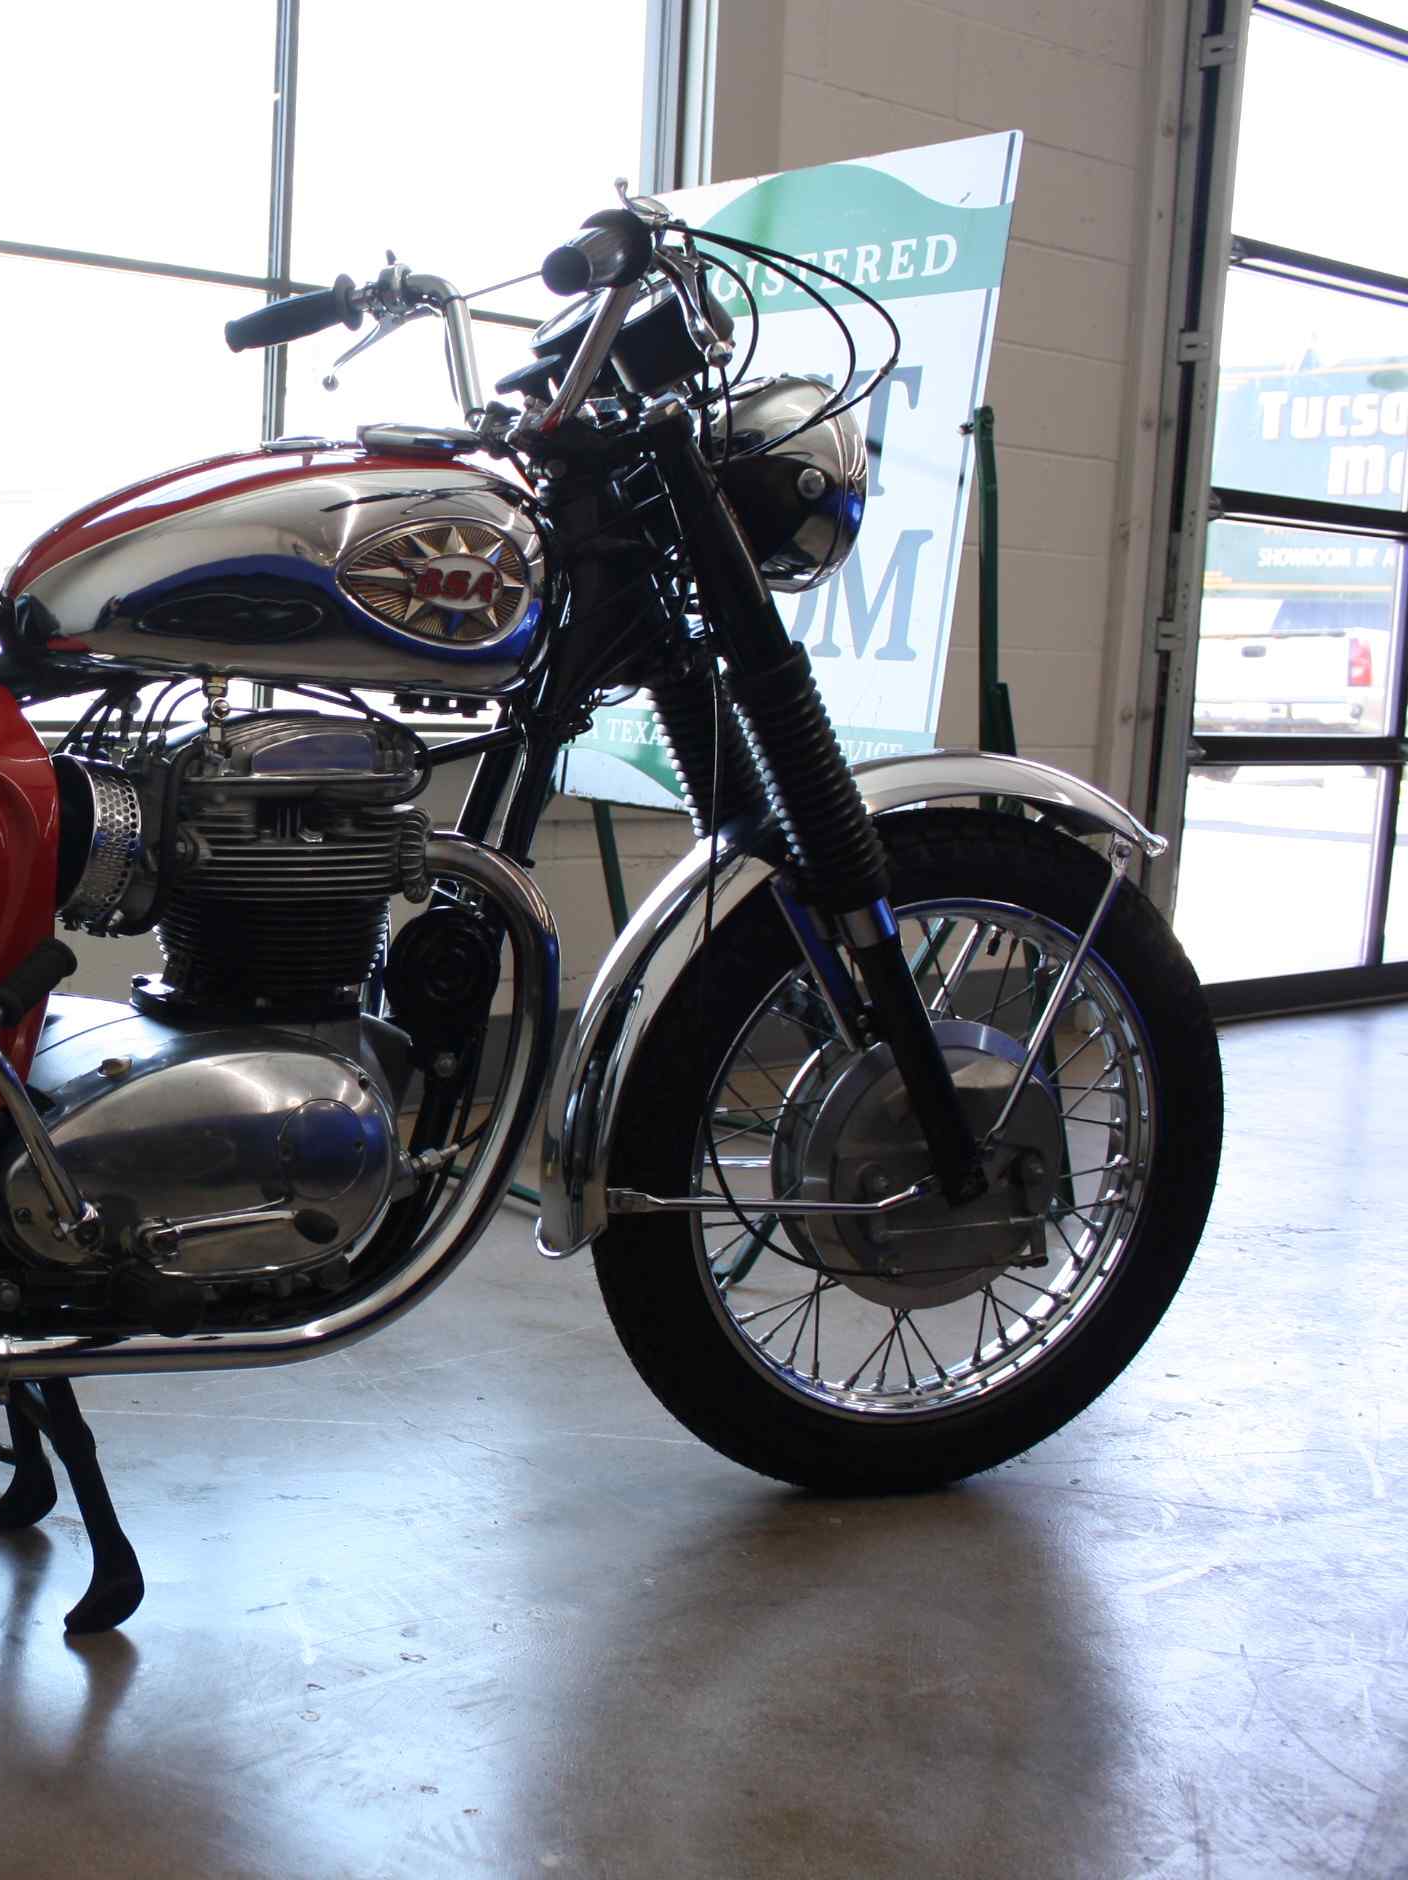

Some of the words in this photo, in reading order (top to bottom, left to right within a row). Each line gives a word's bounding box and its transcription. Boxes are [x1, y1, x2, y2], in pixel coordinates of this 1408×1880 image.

[710, 232, 958, 302] GISTERED
[415, 567, 496, 603] BSA
[607, 718, 666, 746] TEXA
